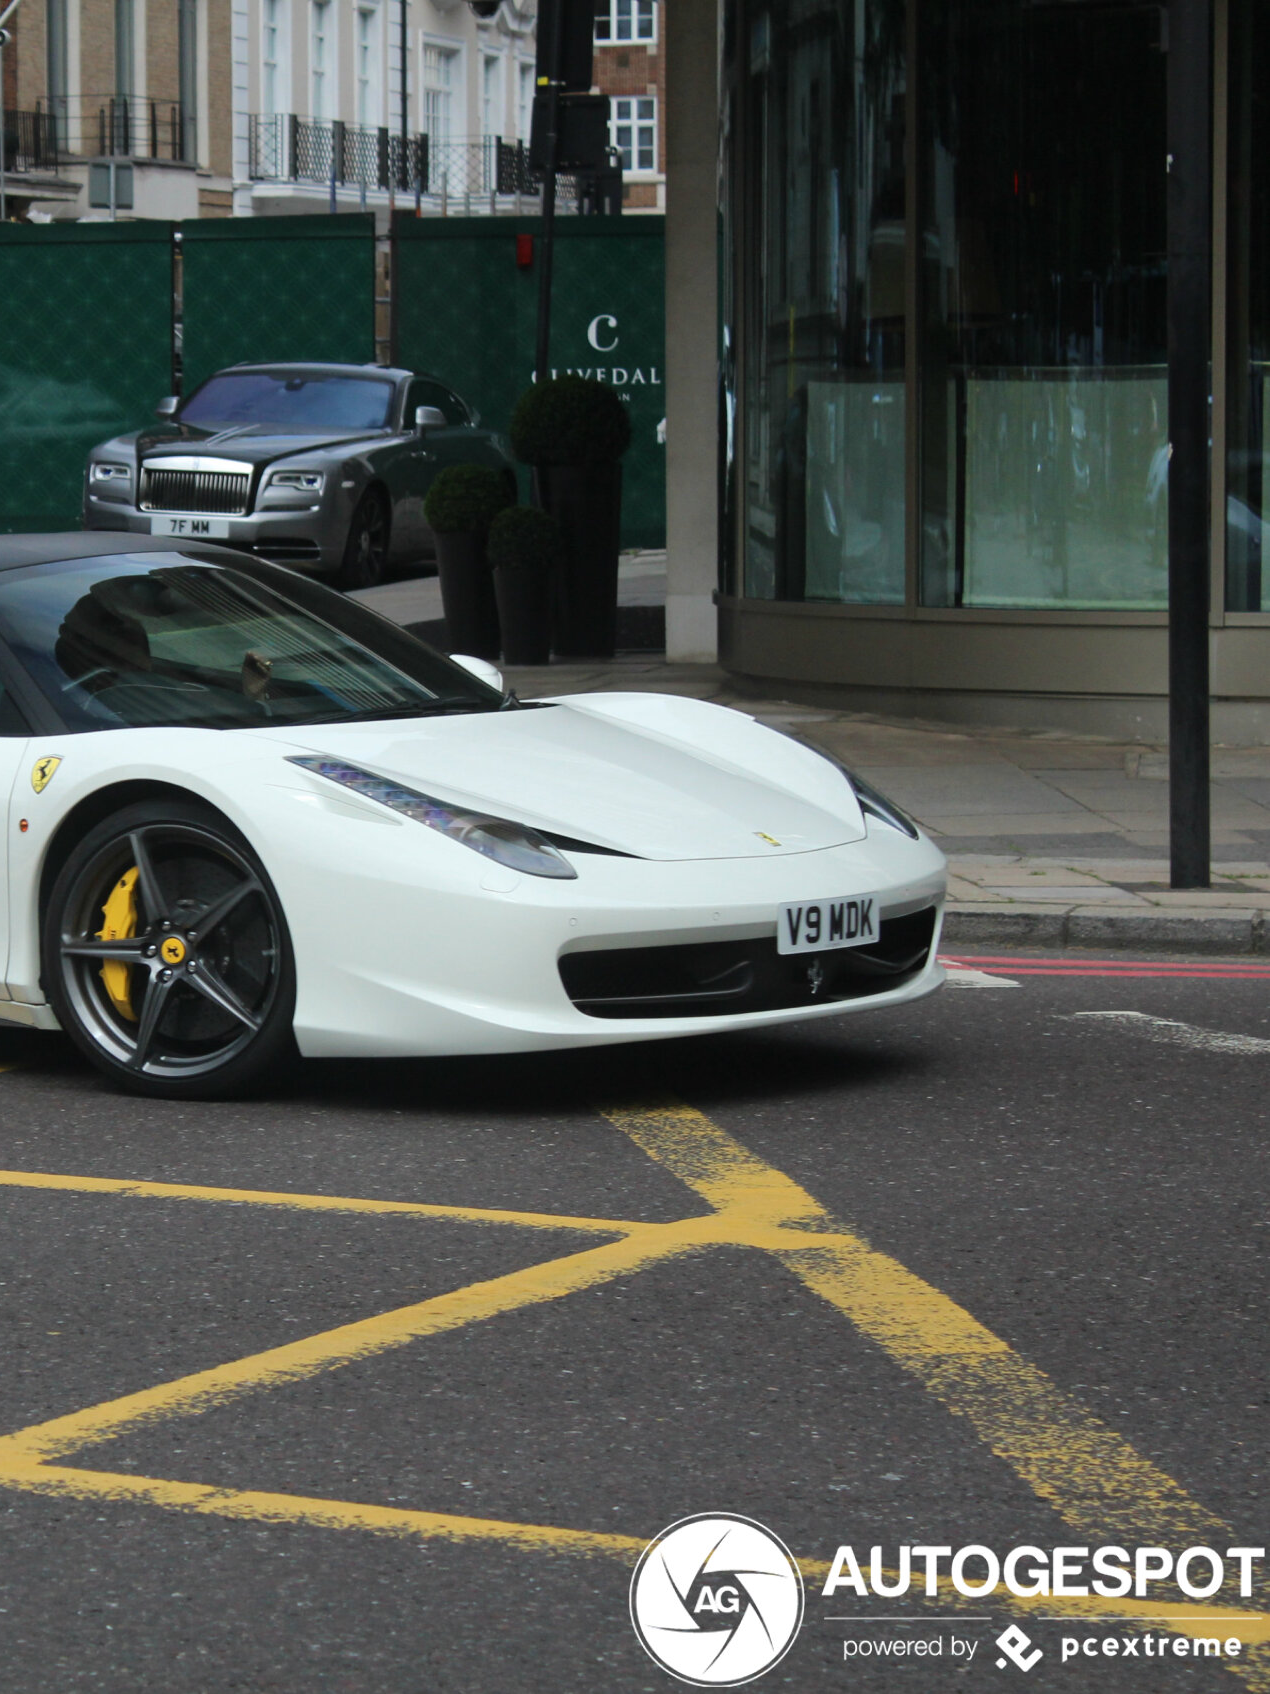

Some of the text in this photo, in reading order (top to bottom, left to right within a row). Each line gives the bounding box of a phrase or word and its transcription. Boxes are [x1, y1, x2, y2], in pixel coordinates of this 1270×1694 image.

[587, 314, 619, 352] C
[170, 519, 187, 533] 7F
[786, 898, 874, 946] V9 MDK
